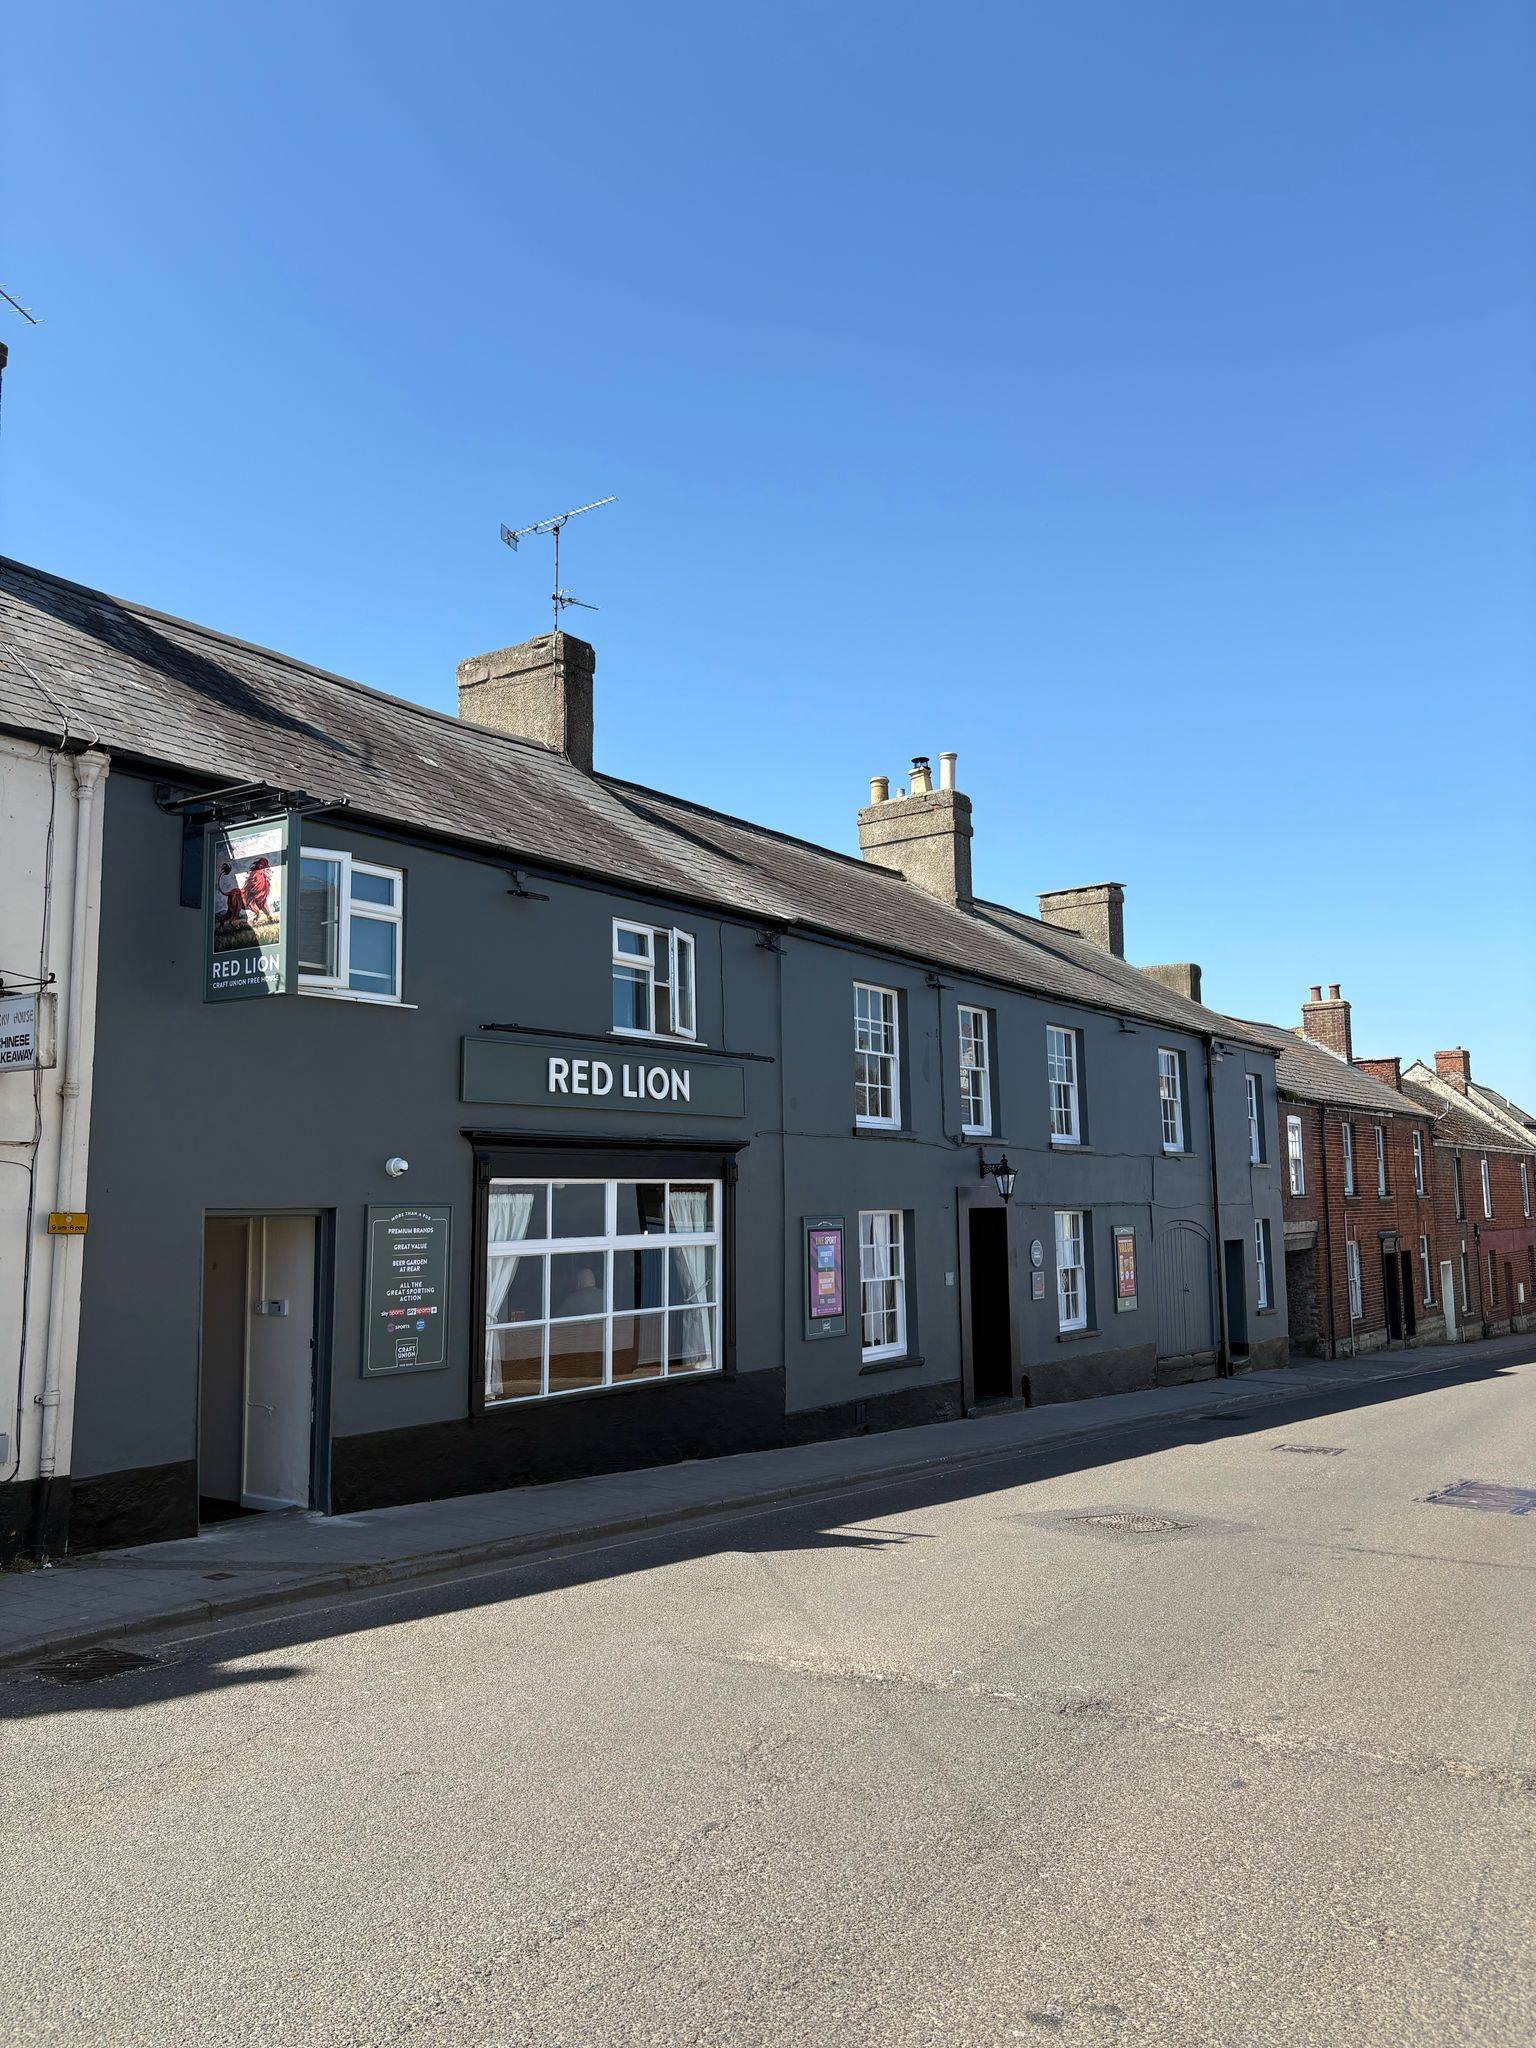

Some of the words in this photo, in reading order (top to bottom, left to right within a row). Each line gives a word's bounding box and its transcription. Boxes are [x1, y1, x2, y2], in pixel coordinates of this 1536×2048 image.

[213, 960, 240, 978] RED
[245, 954, 280, 974] LION
[0, 1013, 10, 1026] KY
[0, 1034, 30, 1048] HINESE
[0, 1048, 34, 1063] KEAWAY
[548, 1057, 613, 1096] RED
[622, 1064, 690, 1102] LION
